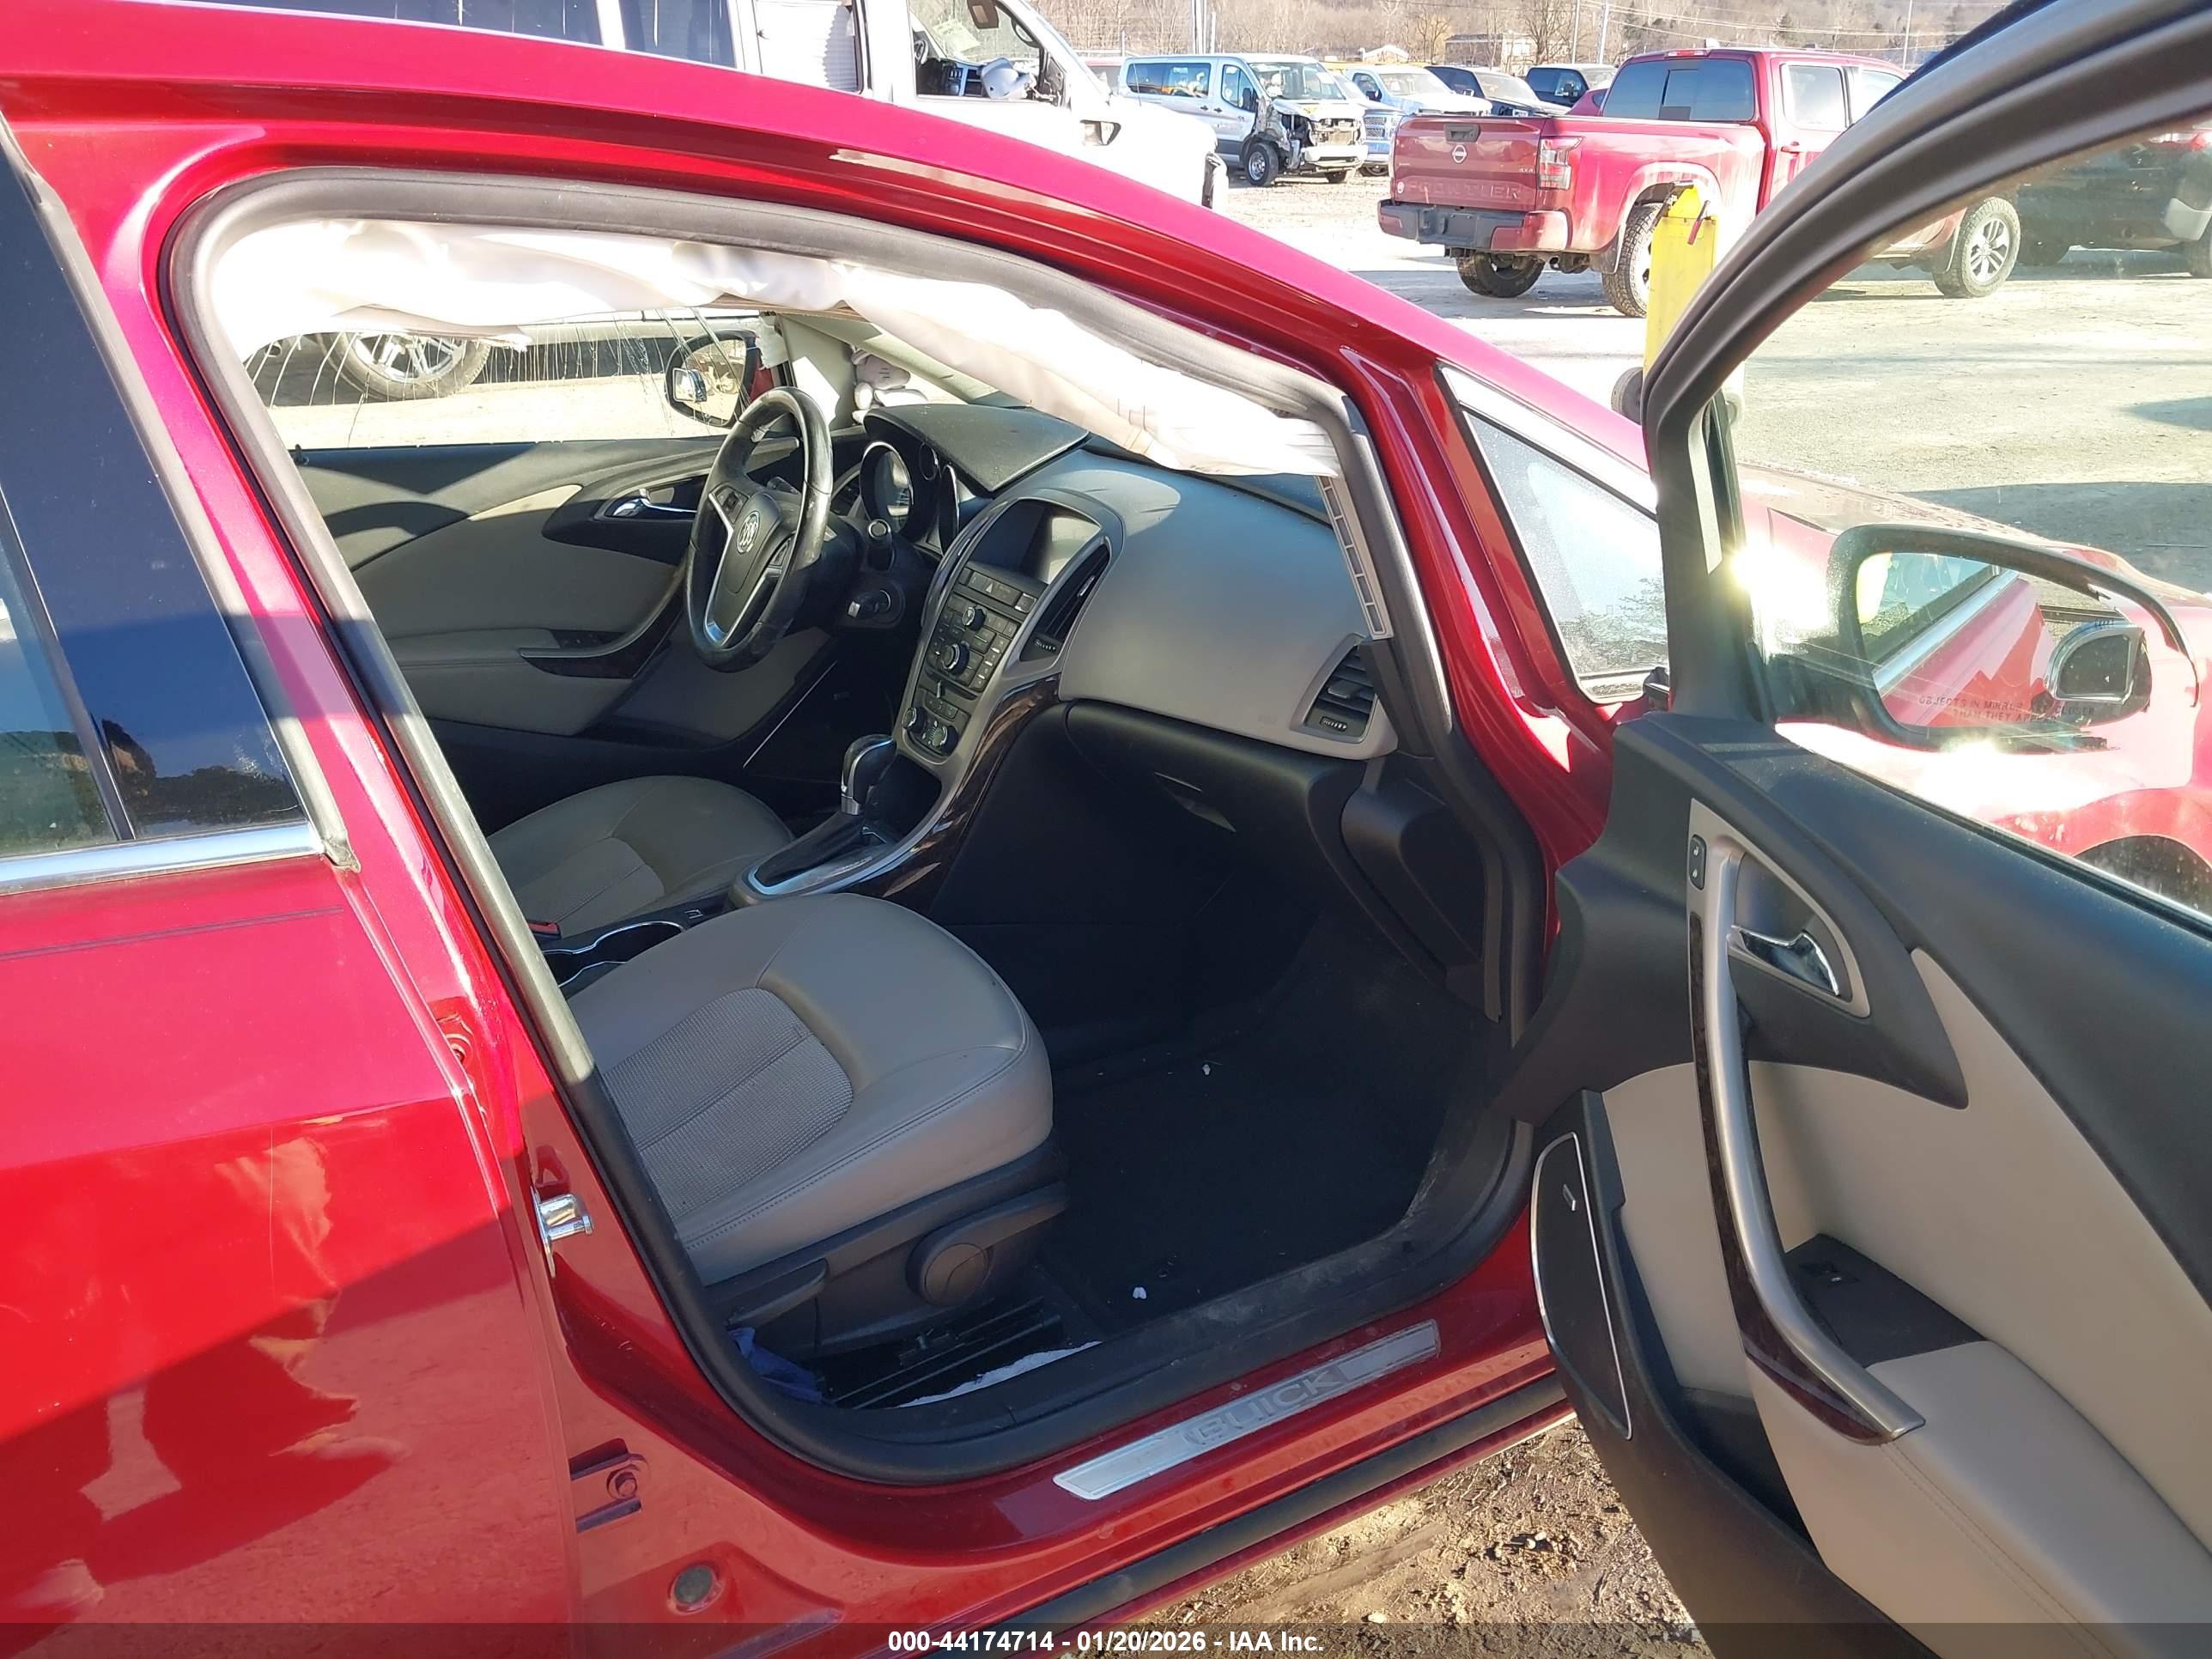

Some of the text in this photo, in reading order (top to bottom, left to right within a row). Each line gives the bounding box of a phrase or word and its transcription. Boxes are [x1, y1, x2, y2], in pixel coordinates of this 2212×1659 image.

[1918, 696, 1966, 708] OBJECTS
[1971, 700, 1979, 708] IN
[2055, 706, 2095, 715] CLOSER
[1953, 708, 1980, 720] THAN
[1985, 712, 2011, 722] THEY
[1194, 1370, 1340, 1444] BUICK
